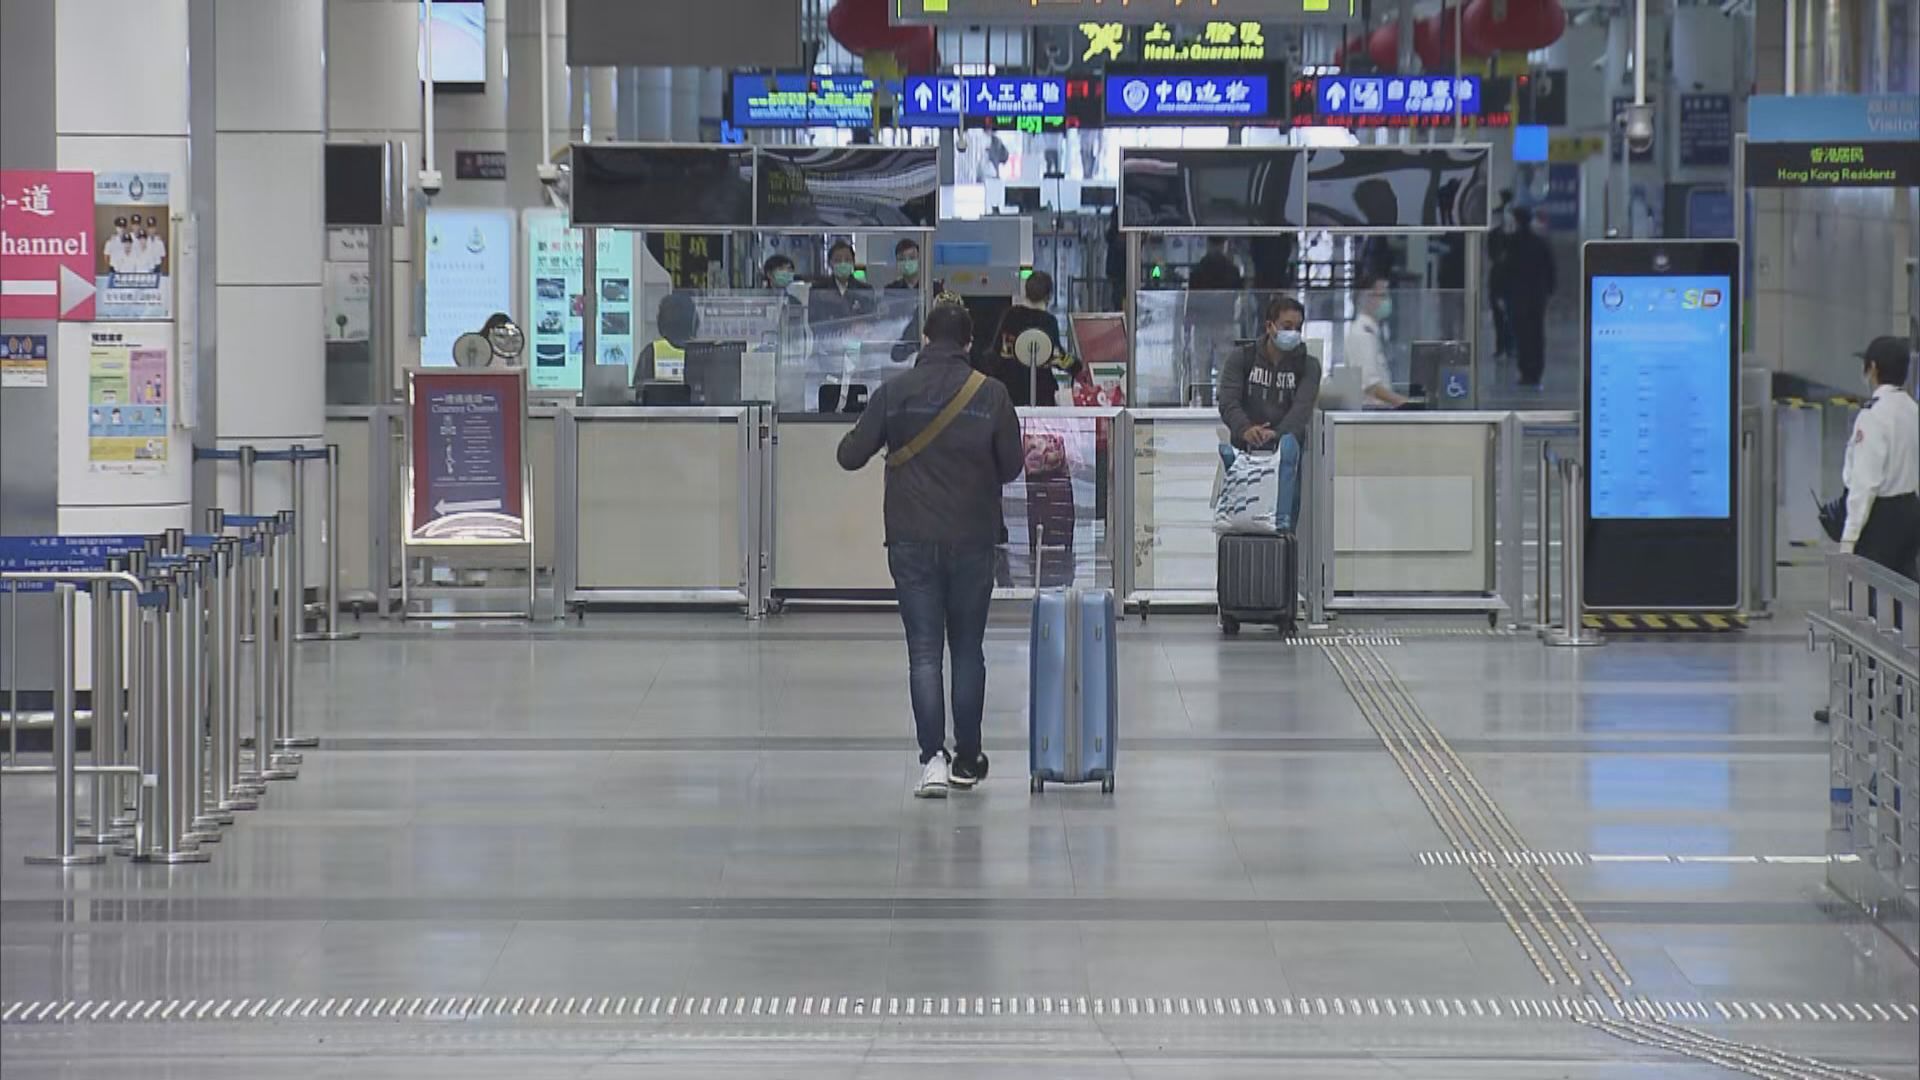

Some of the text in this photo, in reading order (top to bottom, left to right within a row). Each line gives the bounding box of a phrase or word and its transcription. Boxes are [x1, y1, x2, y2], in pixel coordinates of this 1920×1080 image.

[1811, 146, 1865, 163] 香港居民
[1778, 168, 1897, 183] Hong Kong Residents
[65, 537, 123, 546] Immigration
[24, 558, 85, 567] Immigration
